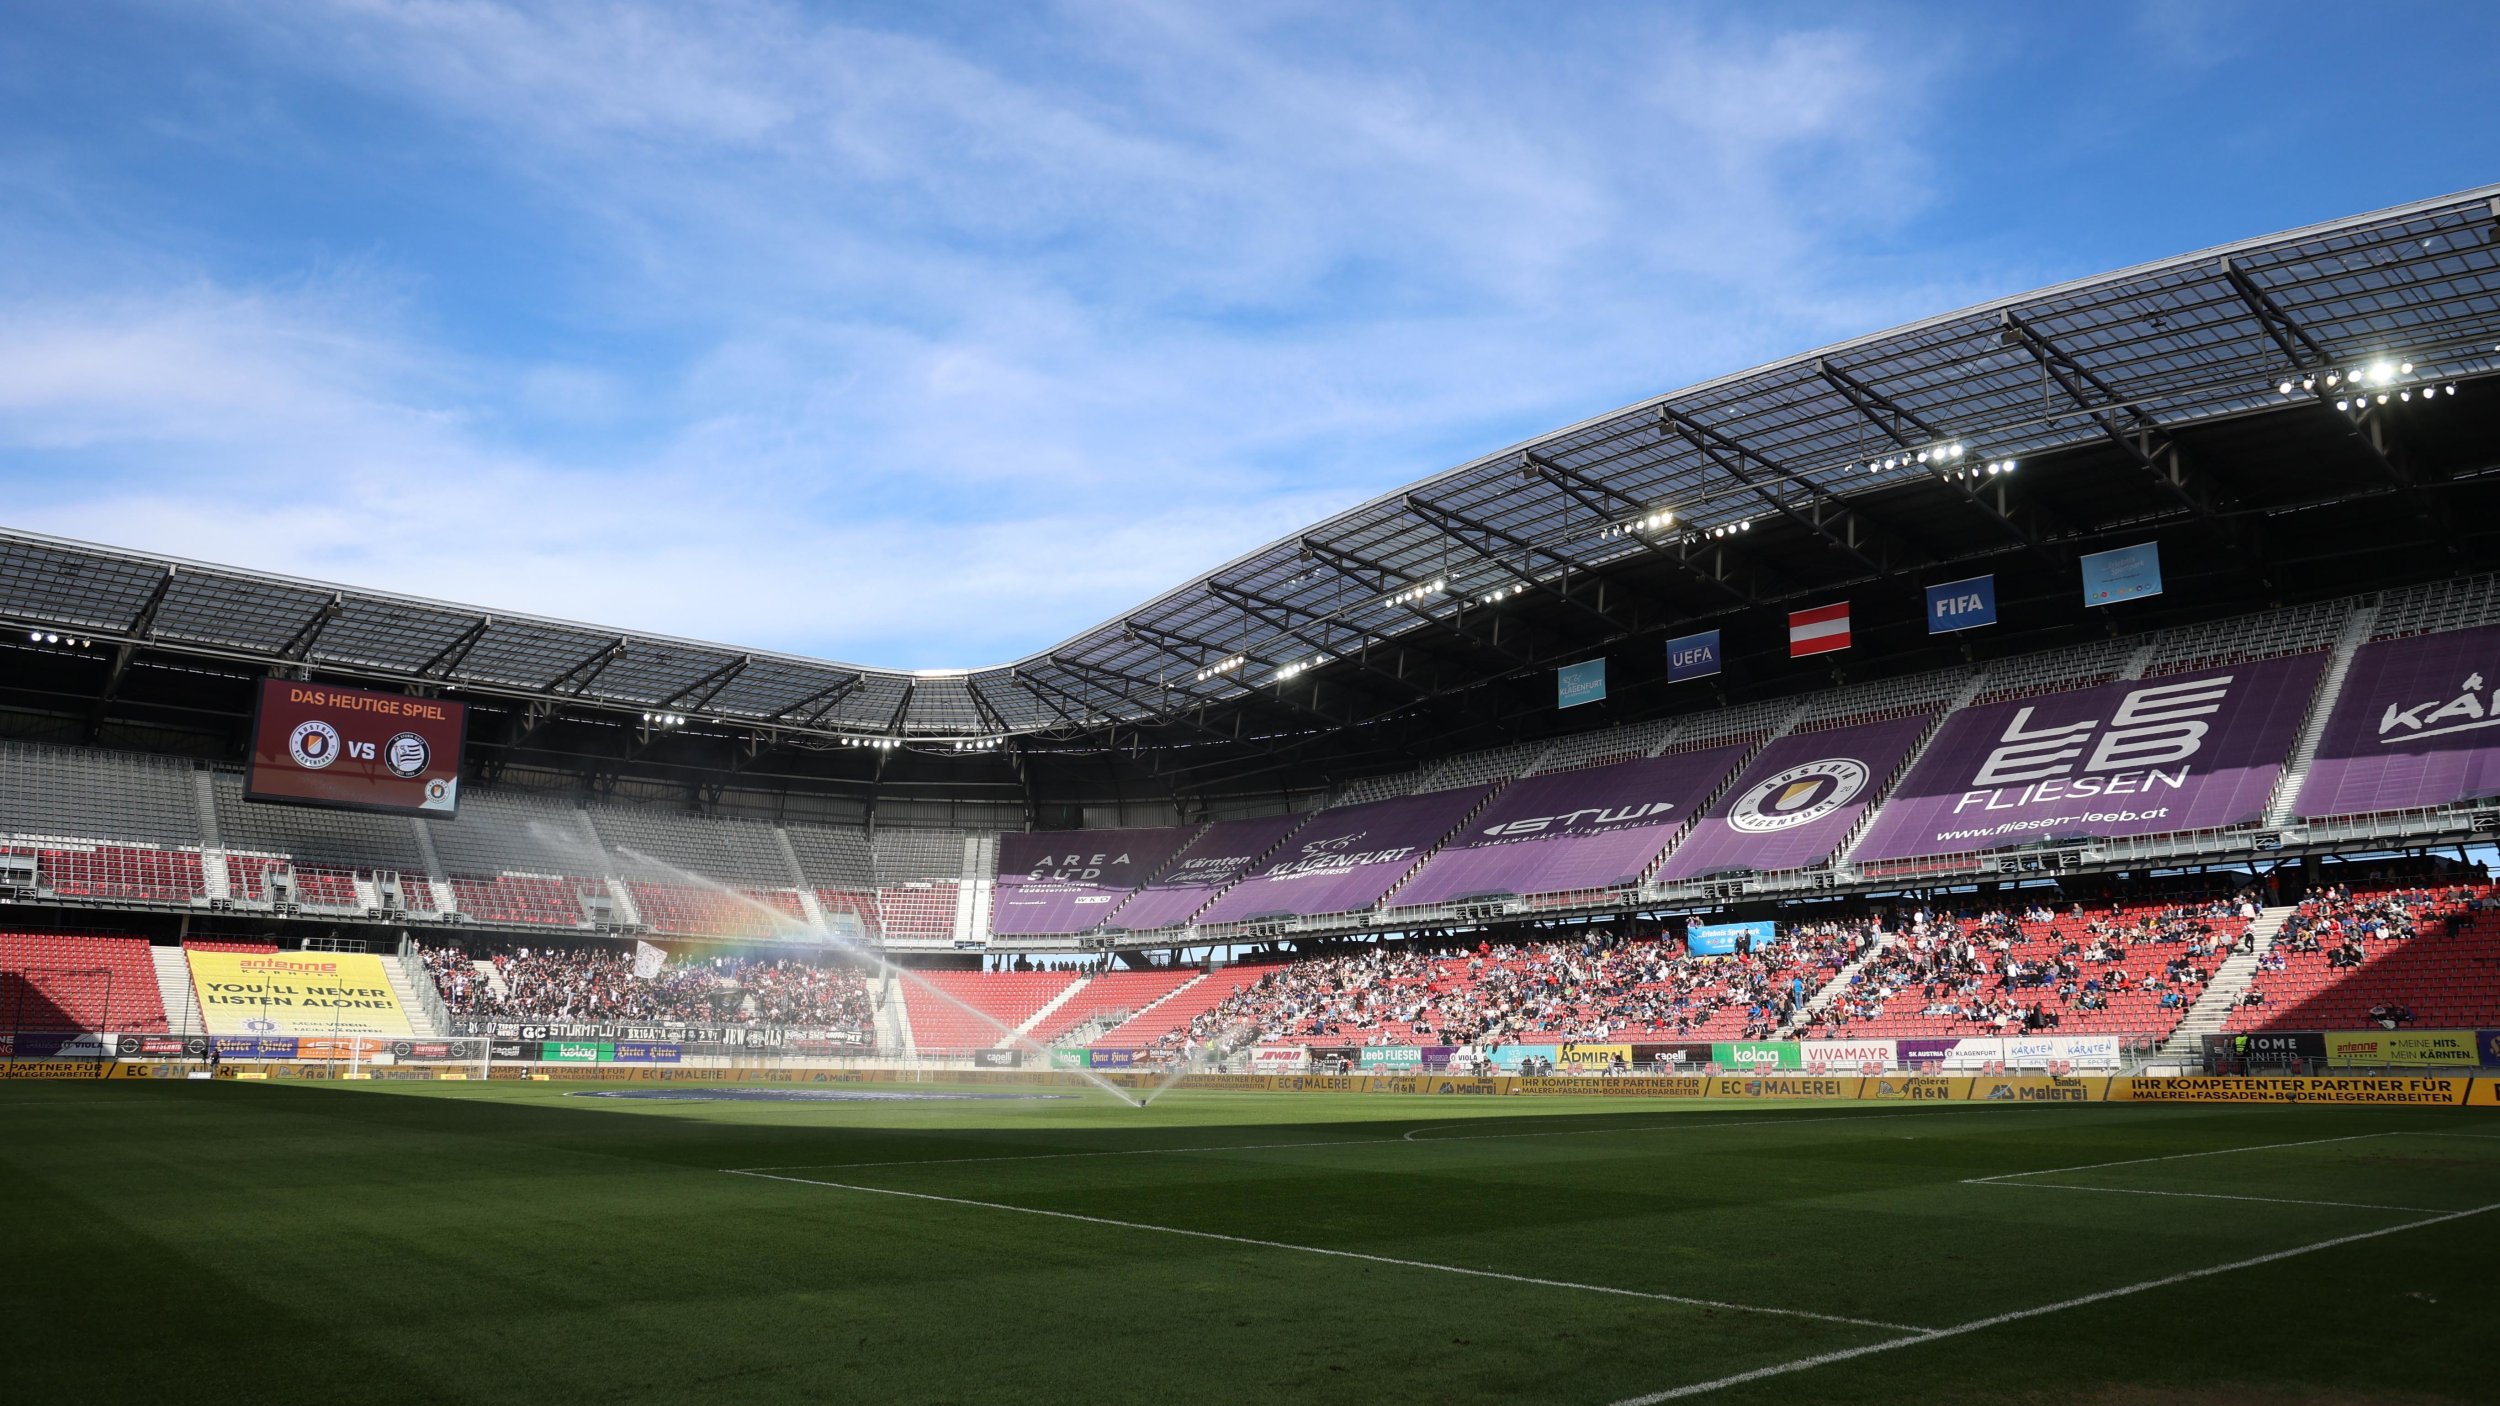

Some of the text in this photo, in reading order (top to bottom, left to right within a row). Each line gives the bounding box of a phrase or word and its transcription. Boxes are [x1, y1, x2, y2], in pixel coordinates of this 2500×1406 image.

[1936, 593, 1984, 618] FIFA
[1672, 647, 1713, 667] UEFA
[290, 689, 446, 720] DAS HEUTIGE SPIEL
[348, 741, 376, 760] VS
[1764, 764, 1857, 791] AUSTRIA
[1952, 765, 2192, 814] FLIESEN
[1740, 799, 1836, 828] KLAGENFURT
[1565, 819, 1659, 835] Klagenfurt
[1936, 807, 2170, 841] www.fliesen-leeb.at
[1034, 853, 1131, 867] AREA
[1178, 855, 1251, 870] Kärnten
[1265, 846, 1416, 877] KLAGENFURT
[240, 958, 337, 972] antenne
[307, 986, 386, 998] NEVER
[208, 995, 394, 1009] LISTEN ALONE!
[550, 1024, 625, 1037] STURMFLUT
[2337, 1041, 2378, 1052] antenne
[2398, 1039, 2460, 1048] MEINE HITS.
[560, 1043, 597, 1060] kelag
[986, 1051, 1012, 1063] capelli
[1361, 1050, 1421, 1061] Leeb FLIESEN
[1655, 1050, 1687, 1062] capelli
[1733, 1045, 1779, 1067] kelag
[1808, 1047, 1890, 1060] VIVAMAYR
[2391, 1048, 2474, 1059] MEIN KÄRNTEN.
[11, 1063, 73, 1071] PARTNER
[76, 1062, 103, 1071] FÜR
[126, 1065, 148, 1077] EC
[561, 1068, 605, 1076] PARTNER
[675, 1069, 726, 1080] MALEREI
[1217, 1075, 1249, 1083] PARTNER
[1278, 1078, 1291, 1089] EC
[1305, 1077, 1352, 1089] MALEREI
[1522, 1076, 1700, 1088] IHR KOMPETENTER PARTNER FÜR
[1721, 1080, 1841, 1095] EC MALEREI
[2055, 1078, 2082, 1087] GmbH
[2132, 1076, 2453, 1092] IHR KOMPETENTER PARTNER FÜR
[2020, 1085, 2088, 1101] Malerei
